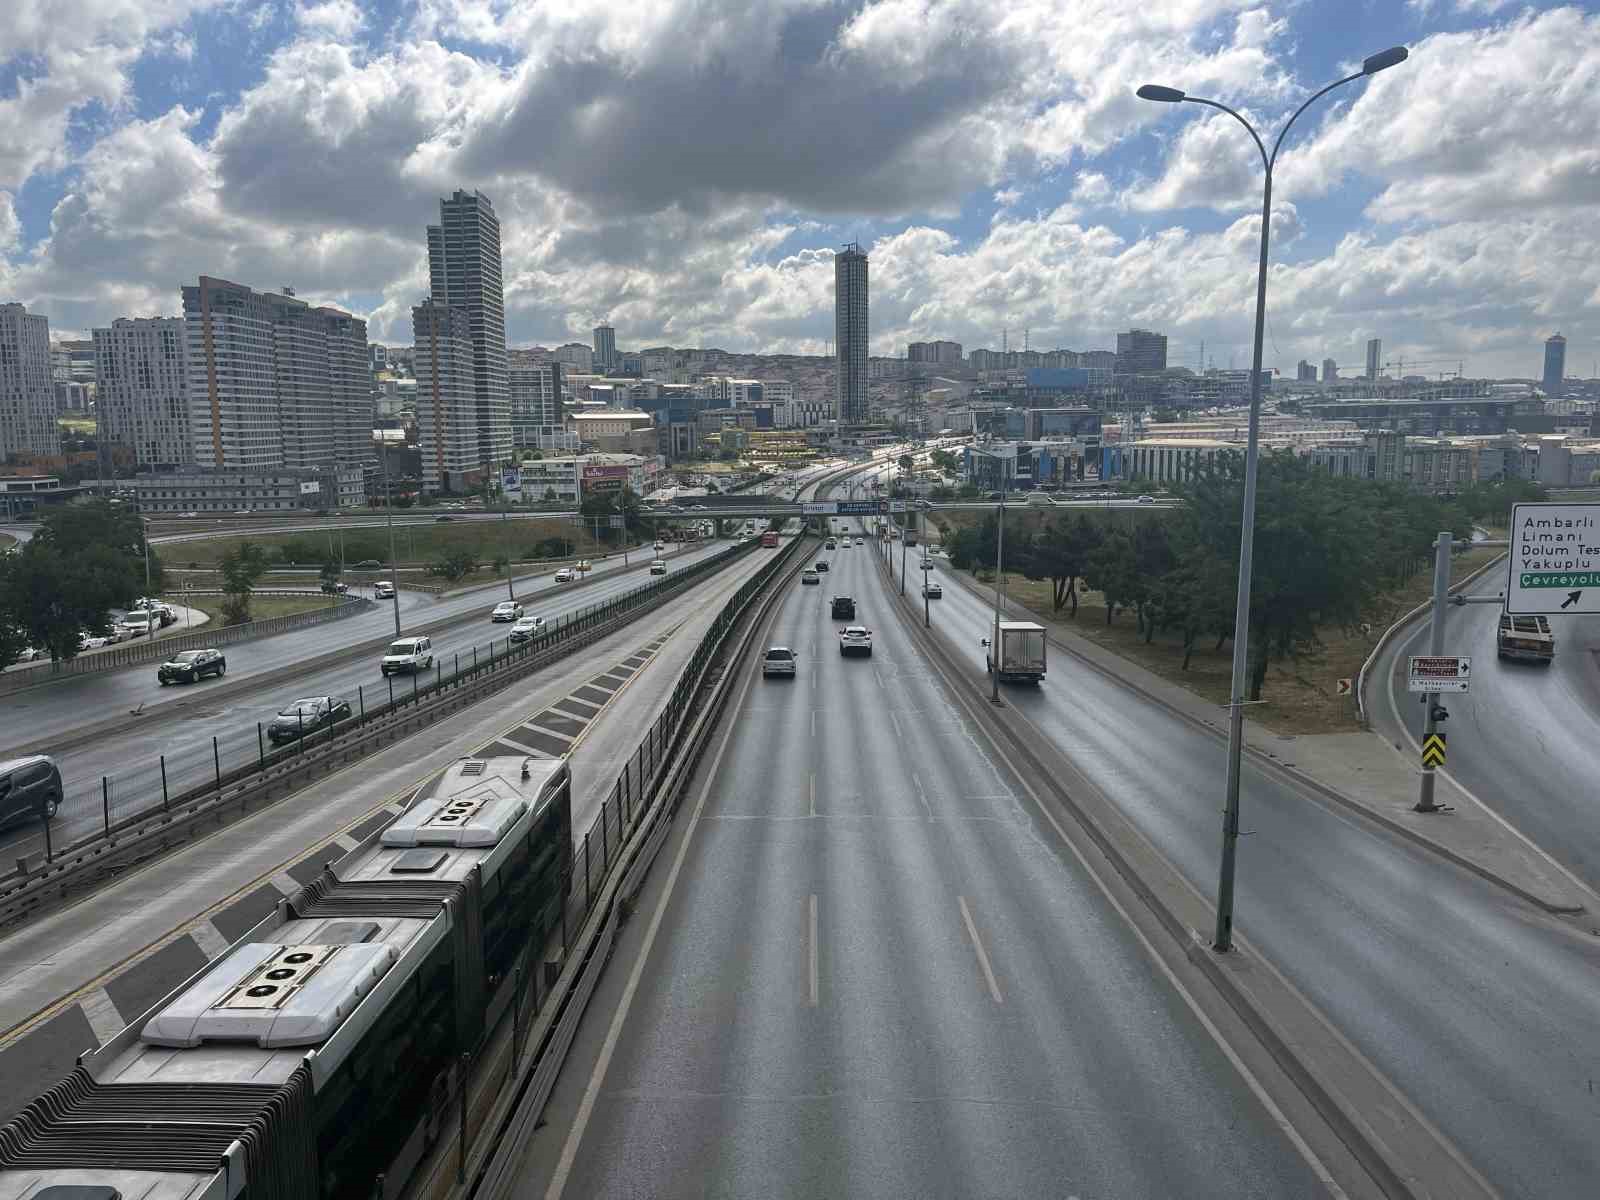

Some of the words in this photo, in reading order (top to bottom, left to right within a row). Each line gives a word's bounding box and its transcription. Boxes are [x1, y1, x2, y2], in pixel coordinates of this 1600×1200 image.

[1524, 516, 1593, 528] Ambarlı
[1522, 531, 1582, 542] Limanı
[1522, 545, 1569, 556] Dolum
[1522, 558, 1590, 571] Yakuplu
